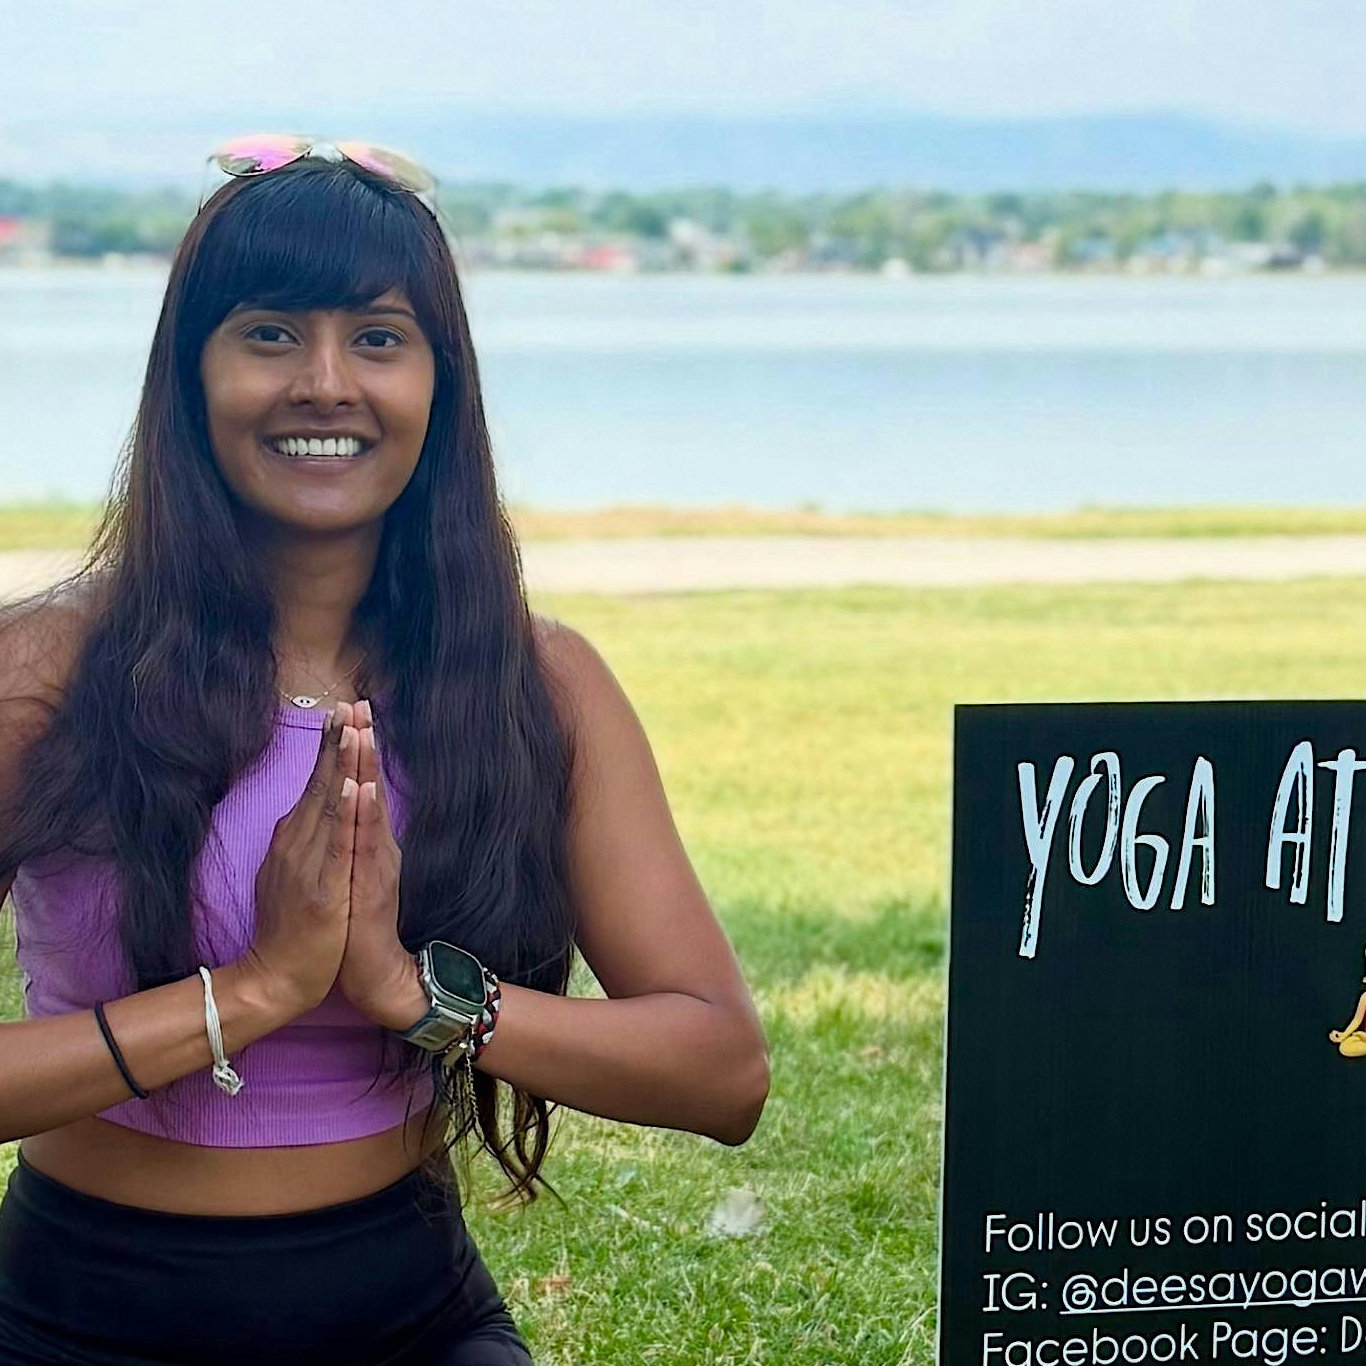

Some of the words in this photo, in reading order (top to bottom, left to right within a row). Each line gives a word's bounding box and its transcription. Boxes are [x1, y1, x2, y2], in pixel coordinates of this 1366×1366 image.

[1018, 752, 1214, 959] YOGA
[986, 1213, 1117, 1252] Follow
[1131, 1218, 1171, 1246] us
[1184, 1215, 1232, 1244] on
[1246, 1200, 1366, 1241] social
[983, 1273, 1047, 1311] IG:
[1213, 1322, 1326, 1366] Page:
